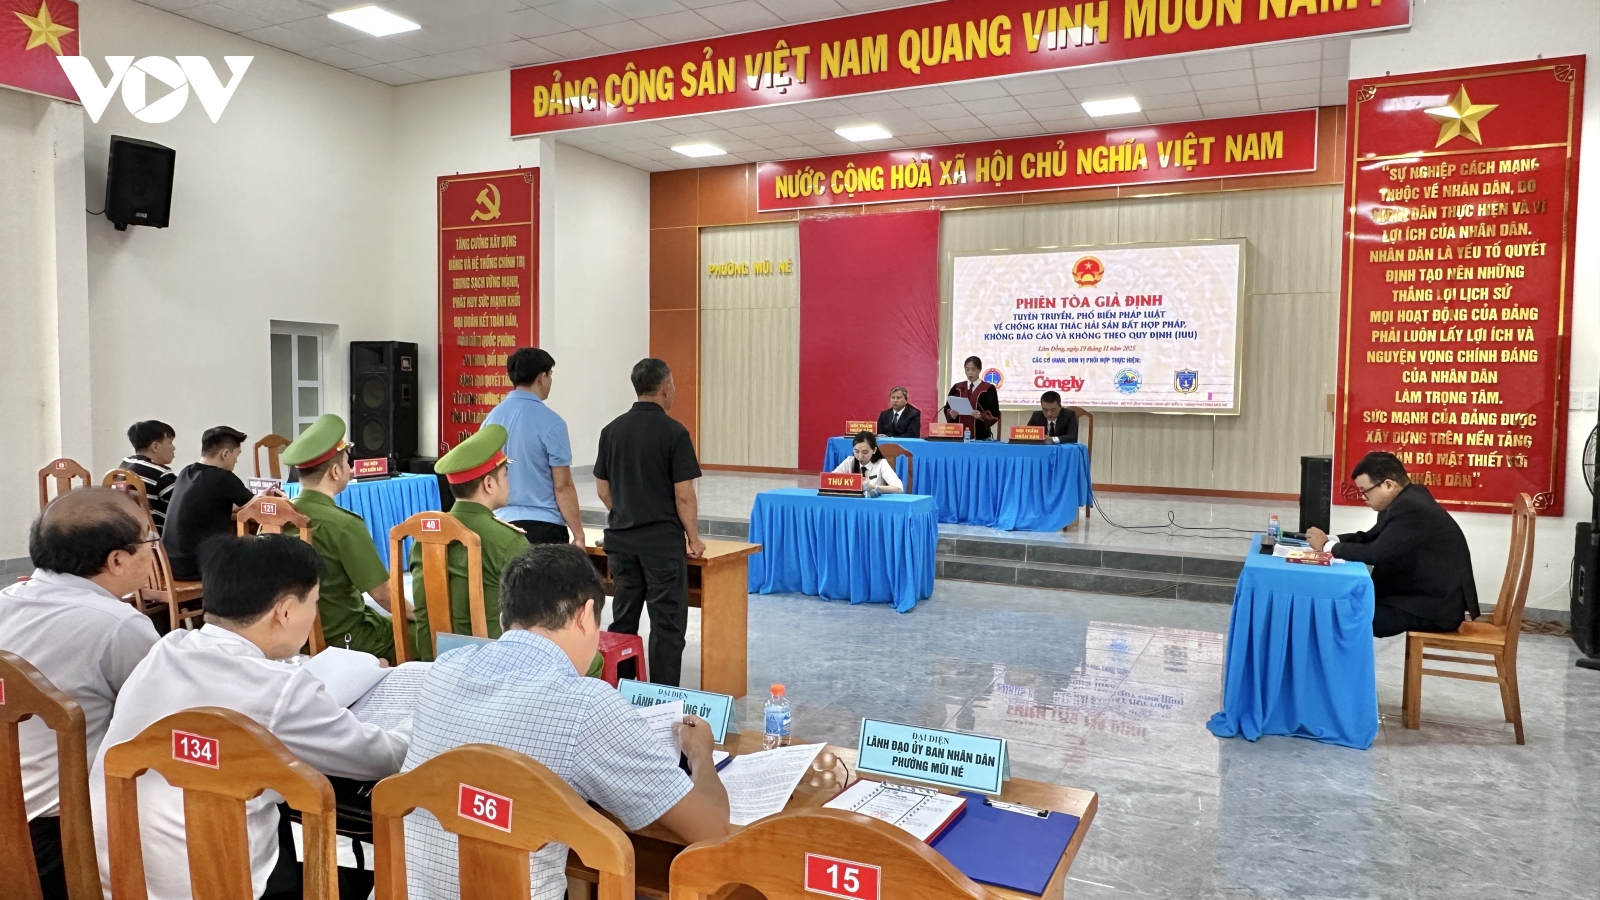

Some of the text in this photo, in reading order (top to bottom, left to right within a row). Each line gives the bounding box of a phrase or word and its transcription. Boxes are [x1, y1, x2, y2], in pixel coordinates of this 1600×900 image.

[533, 70, 599, 117] ĐẢNG
[605, 62, 674, 112] CỘNG
[680, 46, 736, 97] SẢN
[744, 39, 810, 94] VIỆT
[820, 34, 888, 80] NAM
[898, 15, 1012, 74] QUANG
[1022, 1, 1108, 53] VINH
[775, 166, 825, 198] NƯỚC
[830, 162, 884, 197] CỘNG
[938, 153, 967, 186] XÃ
[975, 149, 1013, 186] HỘI
[1020, 140, 1067, 179] CHỦ
[1076, 137, 1148, 175] NGHĨA
[1157, 132, 1215, 172] VIỆT
[1225, 130, 1284, 163] NAM
[1410, 162, 1455, 180] NGHIỆP
[1460, 160, 1495, 176] CÁCH
[1379, 185, 1419, 202] THUỘC
[1443, 182, 1478, 197] NHÂN
[1483, 181, 1514, 196] DÂN,
[1412, 204, 1437, 220] DÂN
[1441, 202, 1473, 221] THỰC
[1478, 201, 1508, 219] HIỆN
[1513, 199, 1529, 214] VÀ
[1382, 222, 1532, 244] LỢI ÍCH CỦA NHÂN DÂN.
[1370, 239, 1546, 263] NHÂN DÂN LÀ YẾU TỐ QUYẾT
[708, 259, 748, 276] PHƯỜNG
[754, 260, 772, 274] MŨI
[1386, 264, 1524, 283] ĐỊNH TẠO NÊN NHỮNG
[1016, 292, 1162, 309] PHIÊN TÒA GIẢ ĐỊNH
[1393, 283, 1512, 303] THẮNG LỢI LỊCH SỬ
[1013, 312, 1038, 320] TUYÊN
[1097, 309, 1116, 319] BIẾN
[1119, 310, 1141, 318] PHÁP
[1144, 309, 1166, 319] LUẬT
[1370, 304, 1538, 325] MỌI HOẠT ĐỘNG CỦA ĐẢNG
[1005, 322, 1034, 330] CHỐNG
[1085, 320, 1099, 330] HẢI
[1102, 320, 1119, 329] SẢN
[1122, 319, 1138, 328] BẤT
[1141, 321, 1160, 330] HỢP
[1162, 319, 1187, 328] PHÁP,
[984, 332, 1013, 340] KHÔNG
[1017, 331, 1033, 340] BÁO
[1036, 331, 1053, 339] CÁO
[1056, 331, 1066, 339] VÀ
[1069, 331, 1101, 340] KHÔNG
[1129, 332, 1147, 340] QUY
[1150, 332, 1172, 340] ĐỊNH
[1175, 331, 1197, 340] (IUU)
[1372, 325, 1534, 344] PHẢI LUÔN LẤY LỢI ÍCH VÀ
[1367, 348, 1537, 365] NGUYỆN VỌNG CHÍNH ĐÁNG
[1402, 367, 1497, 383] CỦA NHÂN DÂN
[1395, 389, 1503, 405] LÀM TRỌNG TÂM.
[1363, 409, 1537, 428] SỨC MẠNH CỦA ĐẢNG ĐƯỢC
[1366, 429, 1389, 443] XÂY
[1393, 431, 1426, 446] DỰNG
[1430, 430, 1462, 445] TRÊN
[1498, 431, 1532, 448] TẢNG
[1437, 452, 1463, 467] MẬT
[1468, 451, 1503, 467] THIẾT
[828, 477, 854, 486] THƯ KÝ
[659, 689, 688, 699] ĐẠI DIỆN
[632, 694, 653, 707] LÃNH
[700, 704, 711, 718] ỦY
[912, 733, 950, 745] ĐẠI DIỆN
[181, 737, 212, 761] 134
[867, 736, 995, 767] LÃNH ĐẠO ỦY BAN NHÂN DÂN
[892, 756, 964, 778] PHƯỜNG MŨI NÉ
[473, 794, 497, 820] 56
[827, 864, 860, 892] 15
